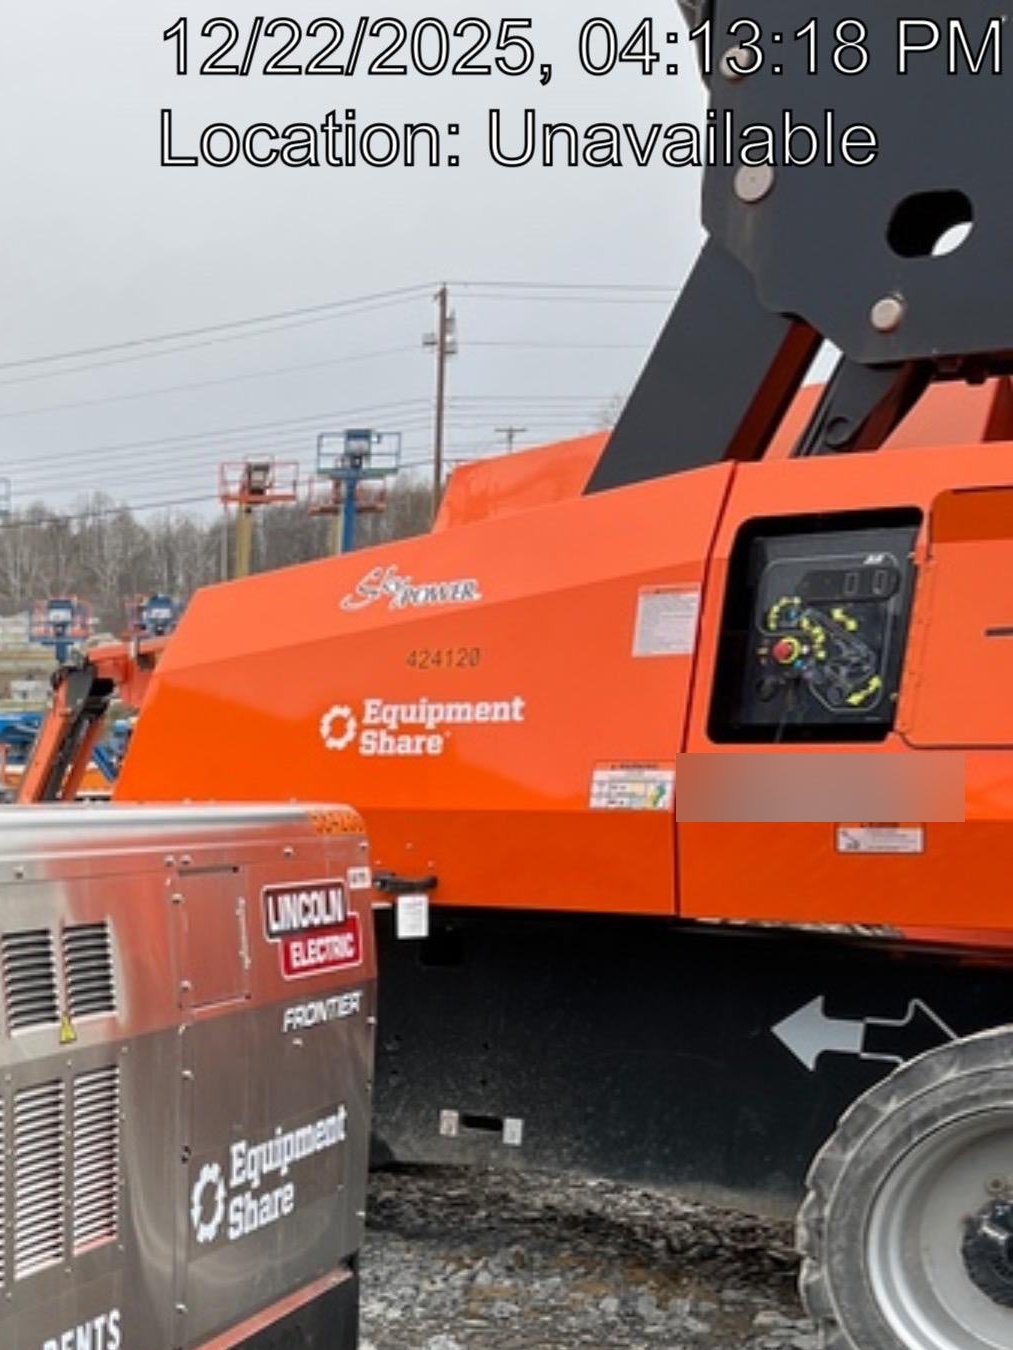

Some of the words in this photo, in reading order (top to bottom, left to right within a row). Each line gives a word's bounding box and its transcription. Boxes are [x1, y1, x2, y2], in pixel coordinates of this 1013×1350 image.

[405, 648, 481, 670] 424120
[361, 696, 525, 730] Equipment
[358, 729, 444, 756] Share
[267, 887, 345, 933] LINCOLN
[289, 932, 356, 969] ELECTRIC
[282, 990, 363, 1033] FRONTIER
[229, 1104, 347, 1189] Equipment
[228, 1182, 295, 1240] Share
